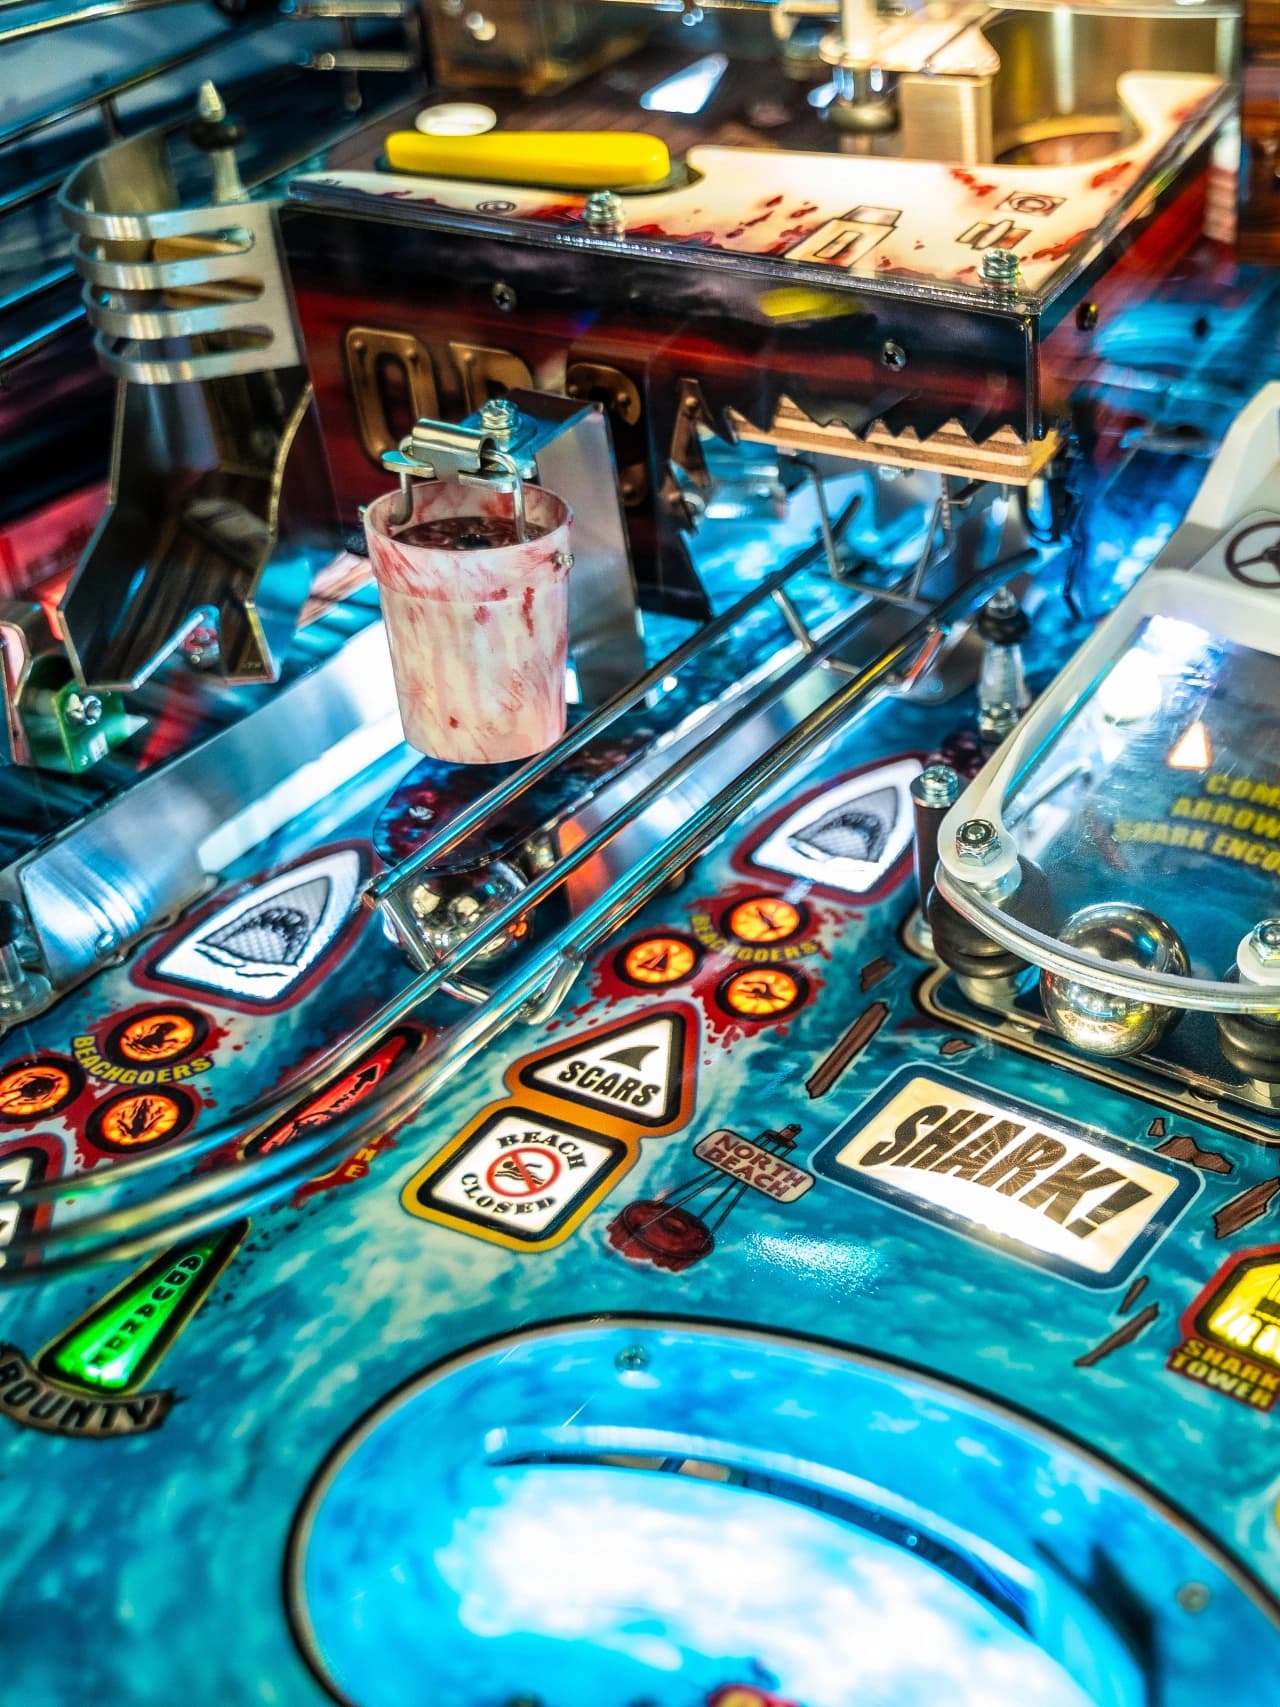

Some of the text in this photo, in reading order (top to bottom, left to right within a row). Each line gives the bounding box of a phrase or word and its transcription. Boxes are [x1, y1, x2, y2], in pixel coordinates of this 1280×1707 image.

[1113, 820, 1210, 850] SHARK
[73, 1035, 212, 1084] BEACHGOERS
[558, 1060, 662, 1106] SCARS
[496, 1131, 588, 1171] BEACH
[704, 1147, 790, 1198] BEACH
[715, 1134, 807, 1188] NORTH
[859, 1105, 1152, 1239] SHARK!
[461, 1172, 559, 1216] CLOSED
[1172, 1352, 1272, 1408] TOWER
